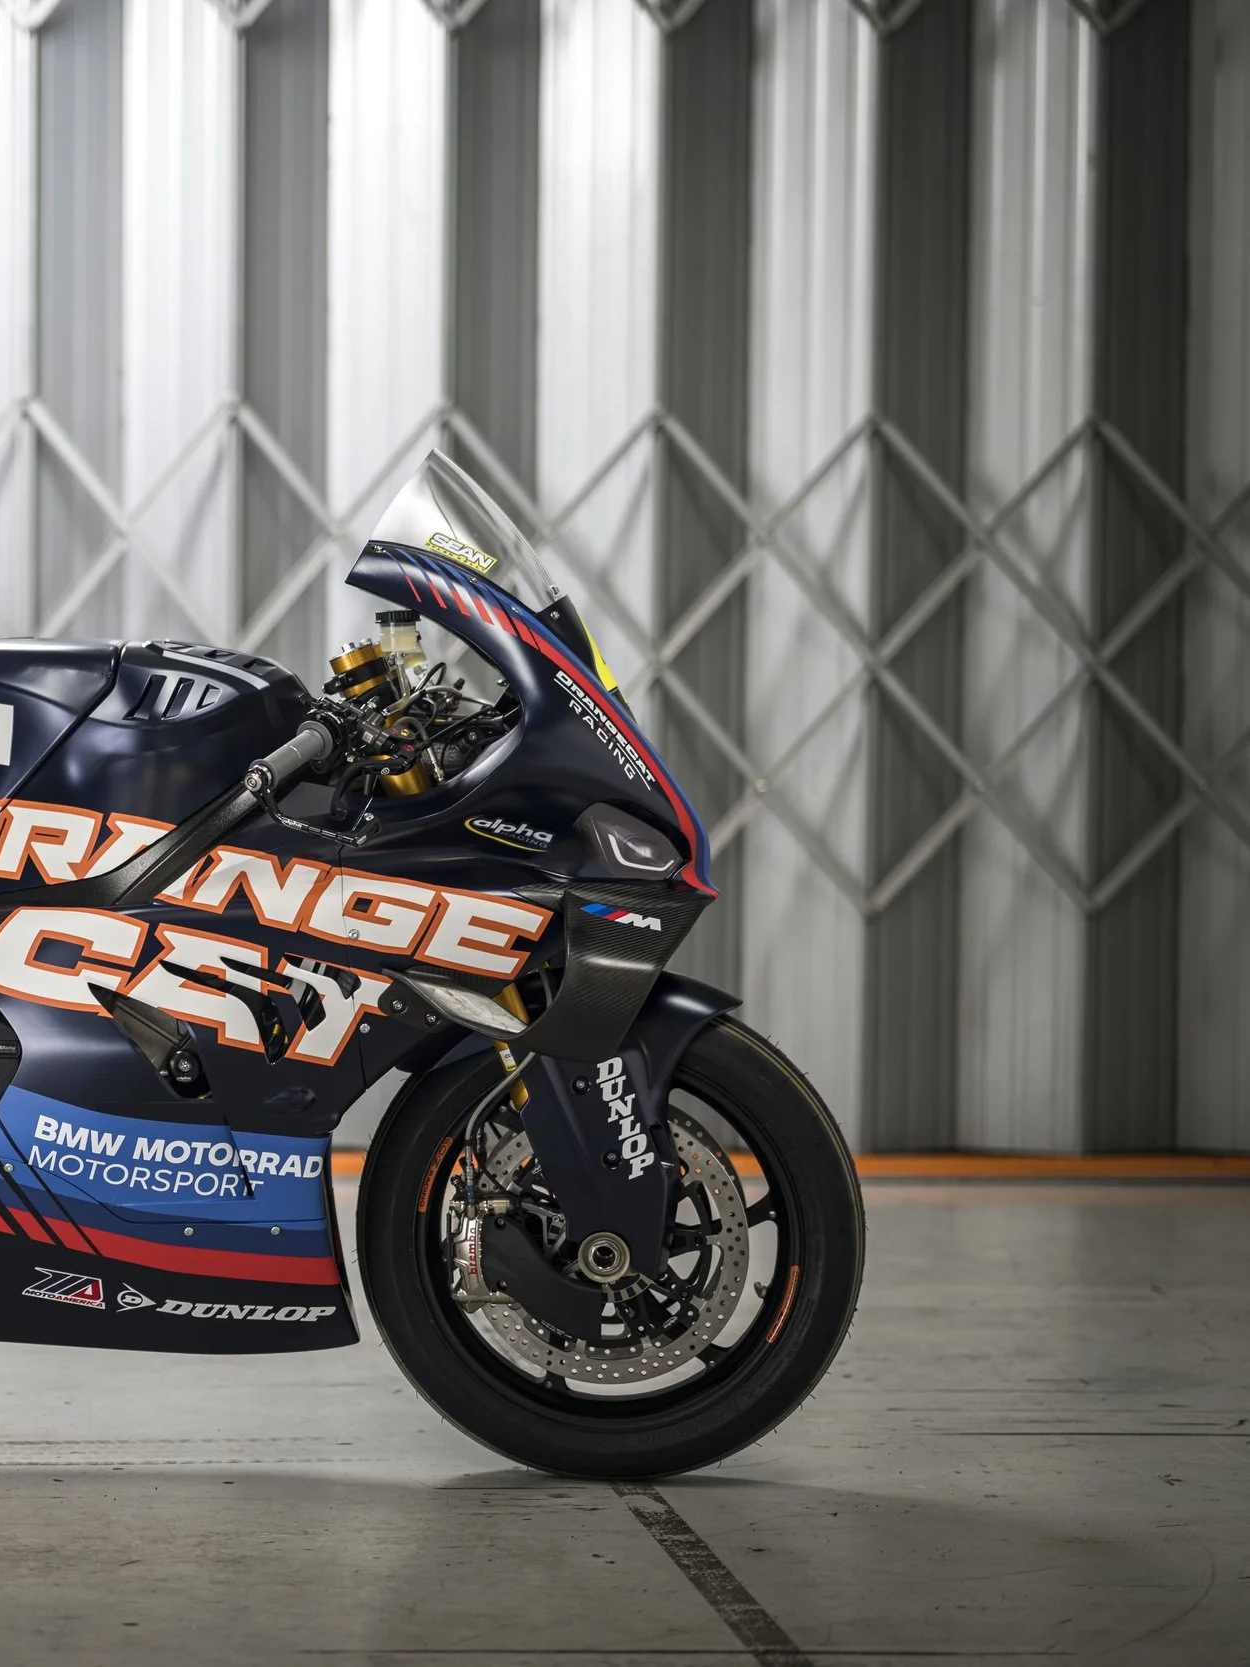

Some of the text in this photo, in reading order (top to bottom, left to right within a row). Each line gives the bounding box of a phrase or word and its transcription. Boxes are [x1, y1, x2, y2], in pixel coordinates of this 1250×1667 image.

[430, 532, 493, 570] SEAN
[556, 670, 656, 784] ORANGECAT
[569, 699, 636, 781] RACING
[473, 818, 553, 843] alpha
[500, 831, 548, 849] RACING
[595, 1056, 655, 1180] DUNLOP
[28, 1145, 265, 1198] MOTORSPORT
[34, 1114, 324, 1180] BMW MOTORRAD
[468, 1227, 478, 1276] brembo
[23, 1288, 104, 1308] MOTOAMERICA
[155, 1299, 337, 1322] DUNLOP
